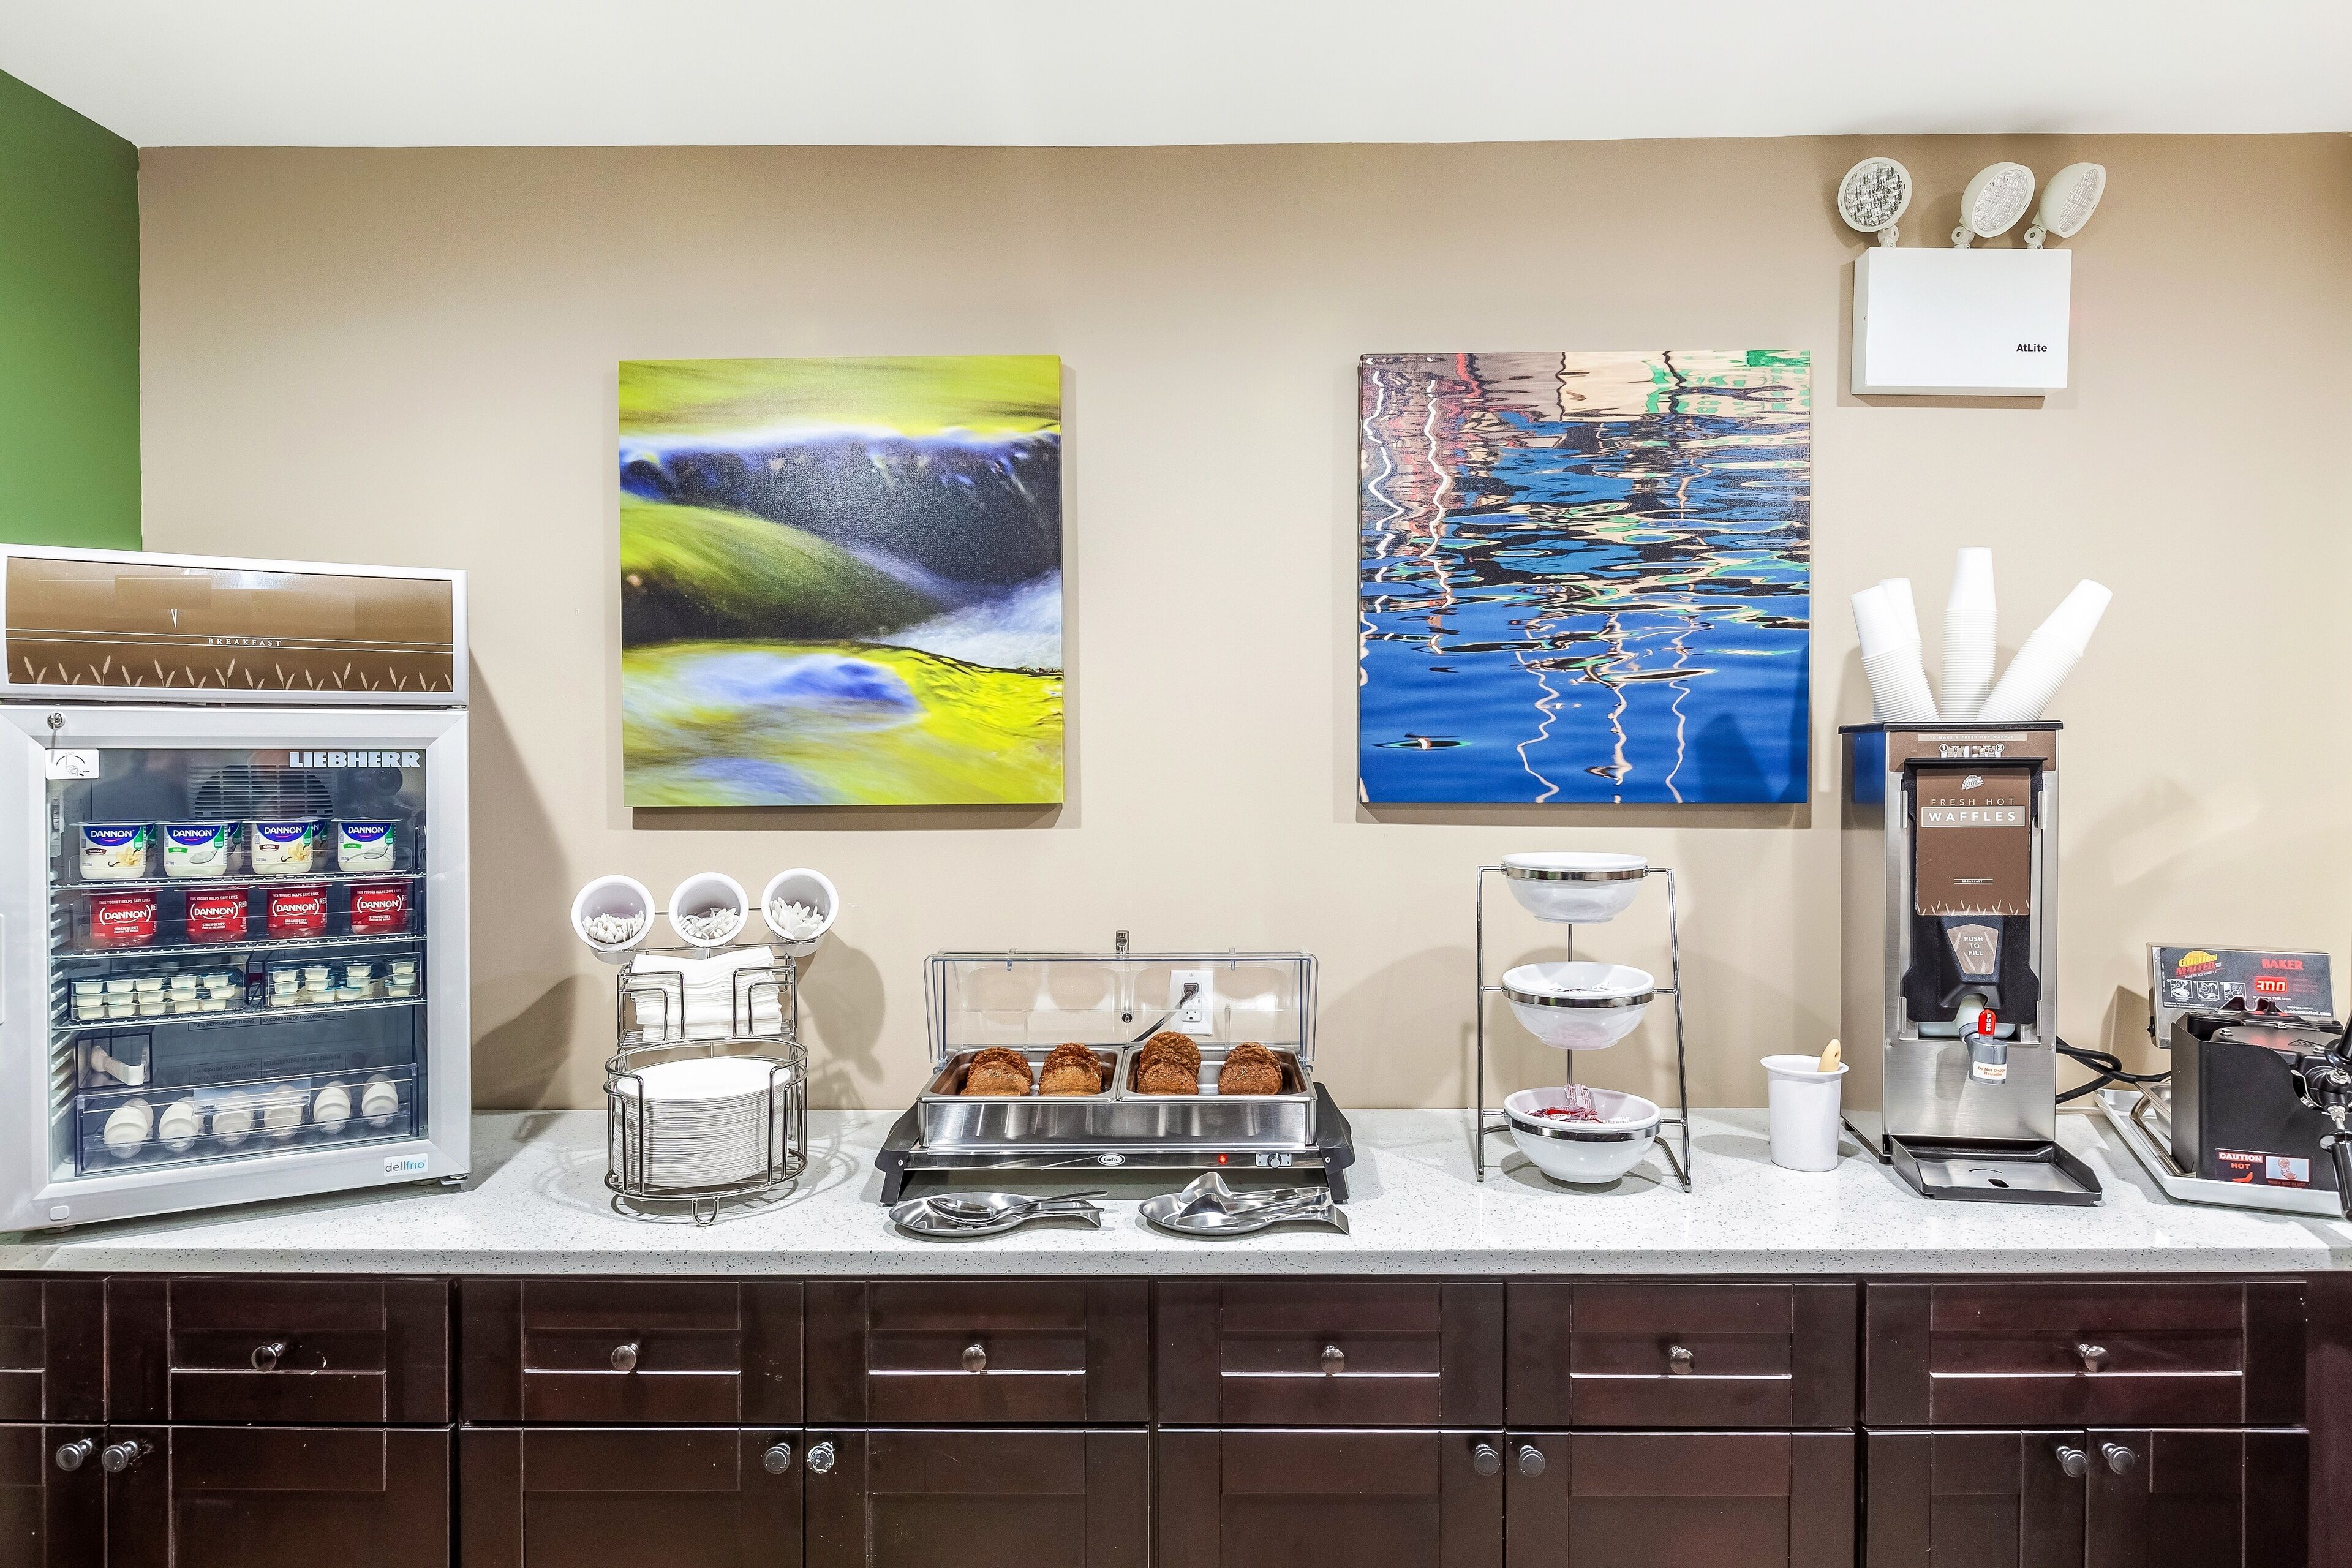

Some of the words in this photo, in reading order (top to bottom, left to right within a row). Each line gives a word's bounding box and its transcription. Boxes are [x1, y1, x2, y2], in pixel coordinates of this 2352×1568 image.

[208, 638, 281, 646] BREAKFAST
[289, 752, 420, 767] LIEBHERR
[1929, 812, 2015, 821] WAFFLES
[2179, 954, 2217, 967] GOLDEN
[2261, 959, 2304, 970] BAKER
[2176, 962, 2215, 976] MALTED
[2218, 1153, 2263, 1162] CAUTION
[385, 1161, 424, 1172] dellfrio
